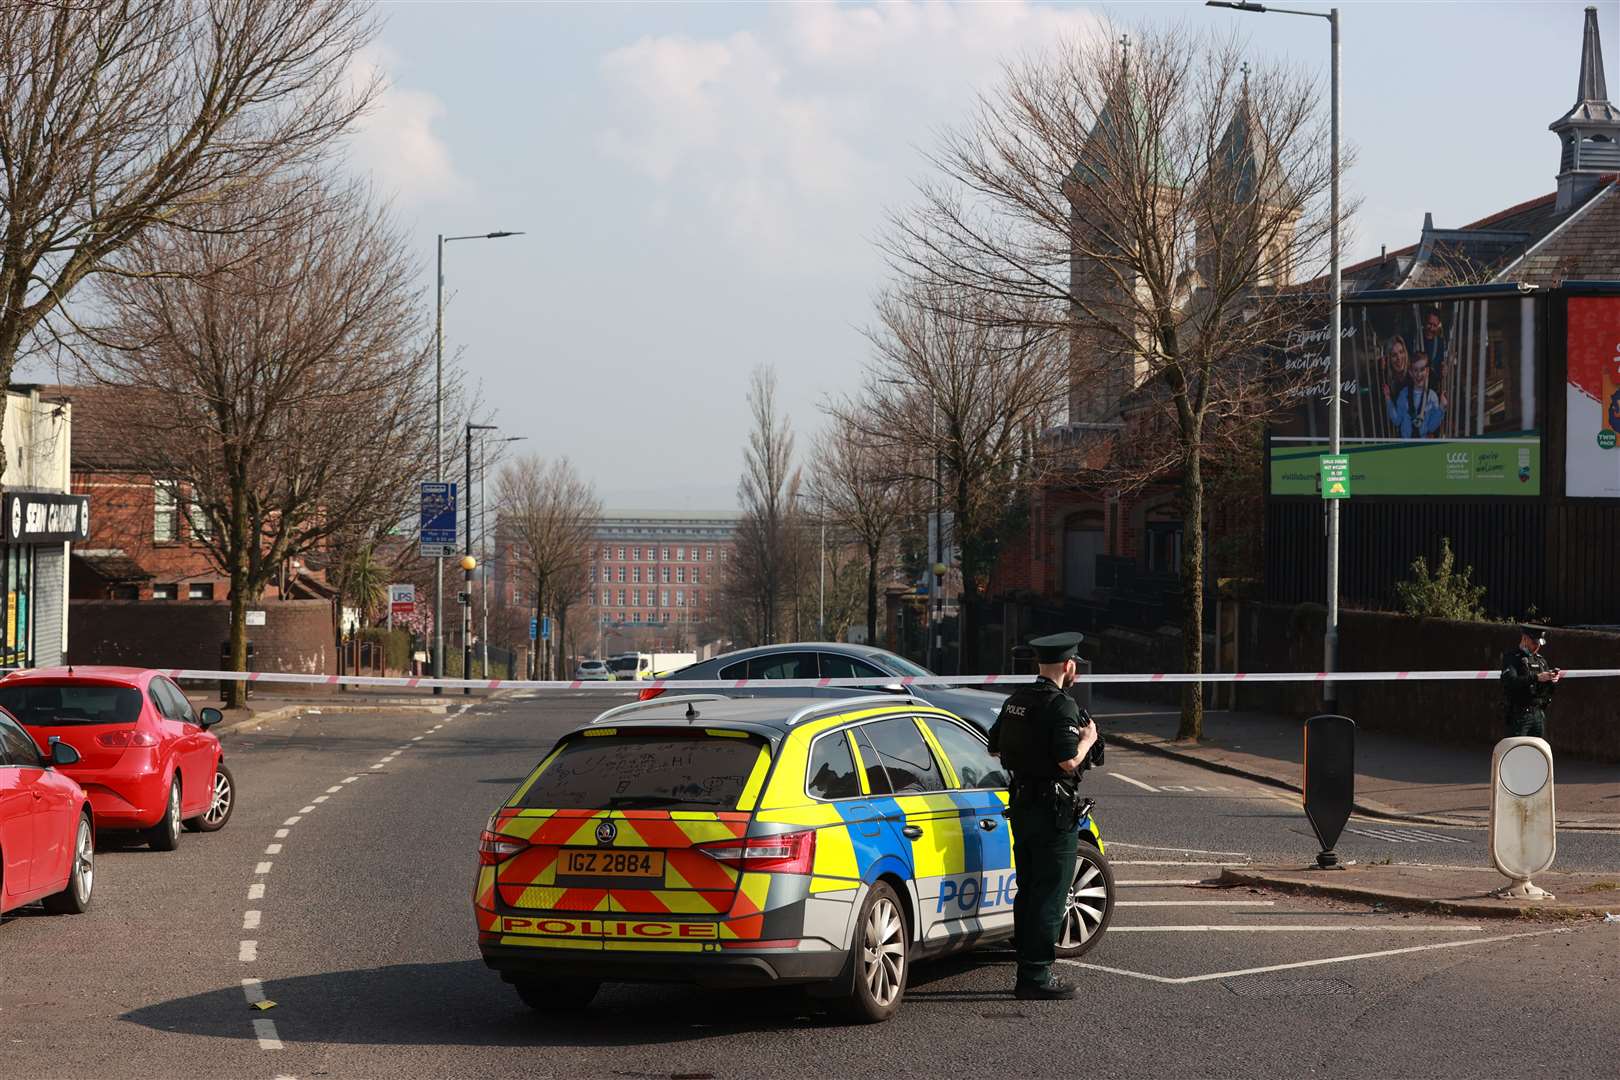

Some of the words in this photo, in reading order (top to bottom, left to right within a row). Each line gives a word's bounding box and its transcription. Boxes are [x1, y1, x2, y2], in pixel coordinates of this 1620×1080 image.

[1286, 325, 1357, 351] Experiece
[392, 592, 413, 602] UPS
[1006, 704, 1027, 717] POLICE
[568, 852, 596, 873] IGZ
[604, 854, 651, 874] 2884
[936, 873, 1017, 914] POLIC
[503, 918, 716, 937] POLICE
